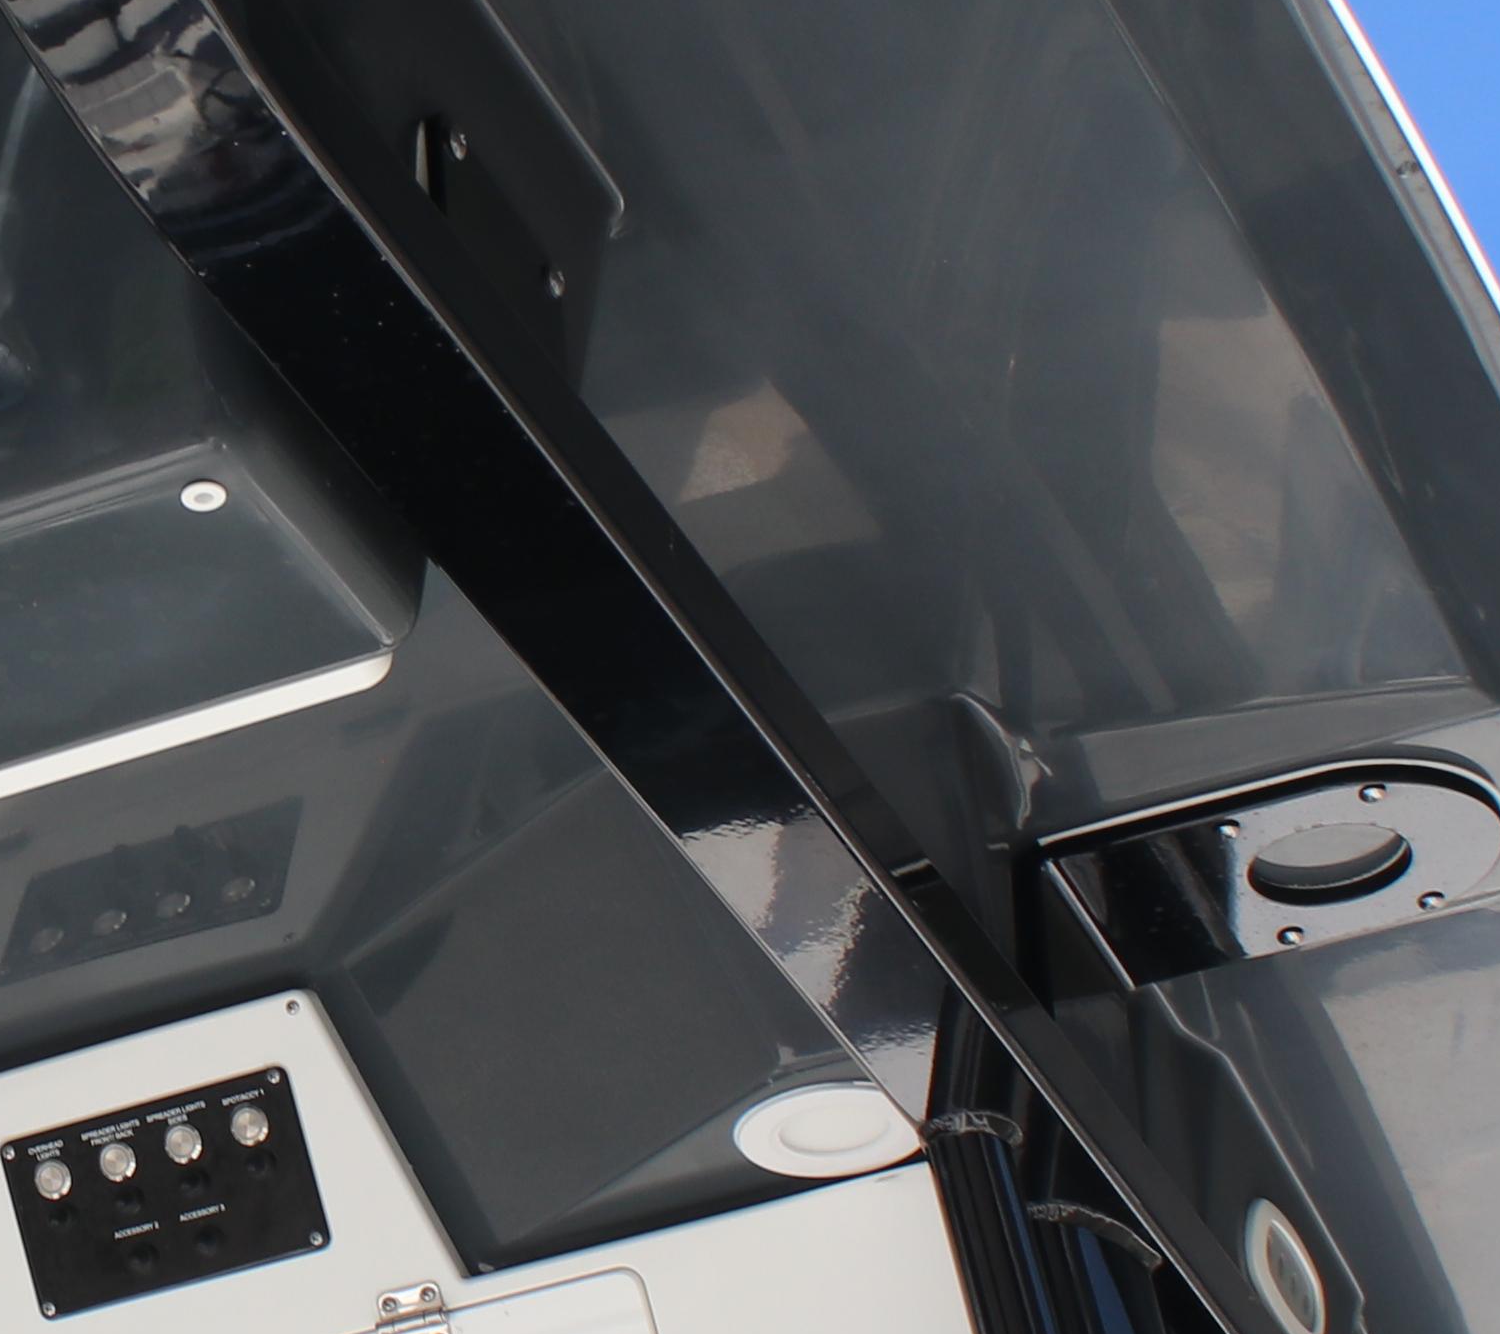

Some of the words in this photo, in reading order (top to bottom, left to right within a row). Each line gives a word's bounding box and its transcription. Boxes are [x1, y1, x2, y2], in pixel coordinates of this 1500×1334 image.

[181, 1100, 206, 1114] LIGHTS
[115, 1118, 140, 1131] LIGHTS
[27, 1139, 64, 1156] OVERHEAD
[35, 1149, 60, 1162] LIGHTS
[179, 1205, 219, 1222] ACCESSORY
[114, 1222, 154, 1240] ACCESSORY
